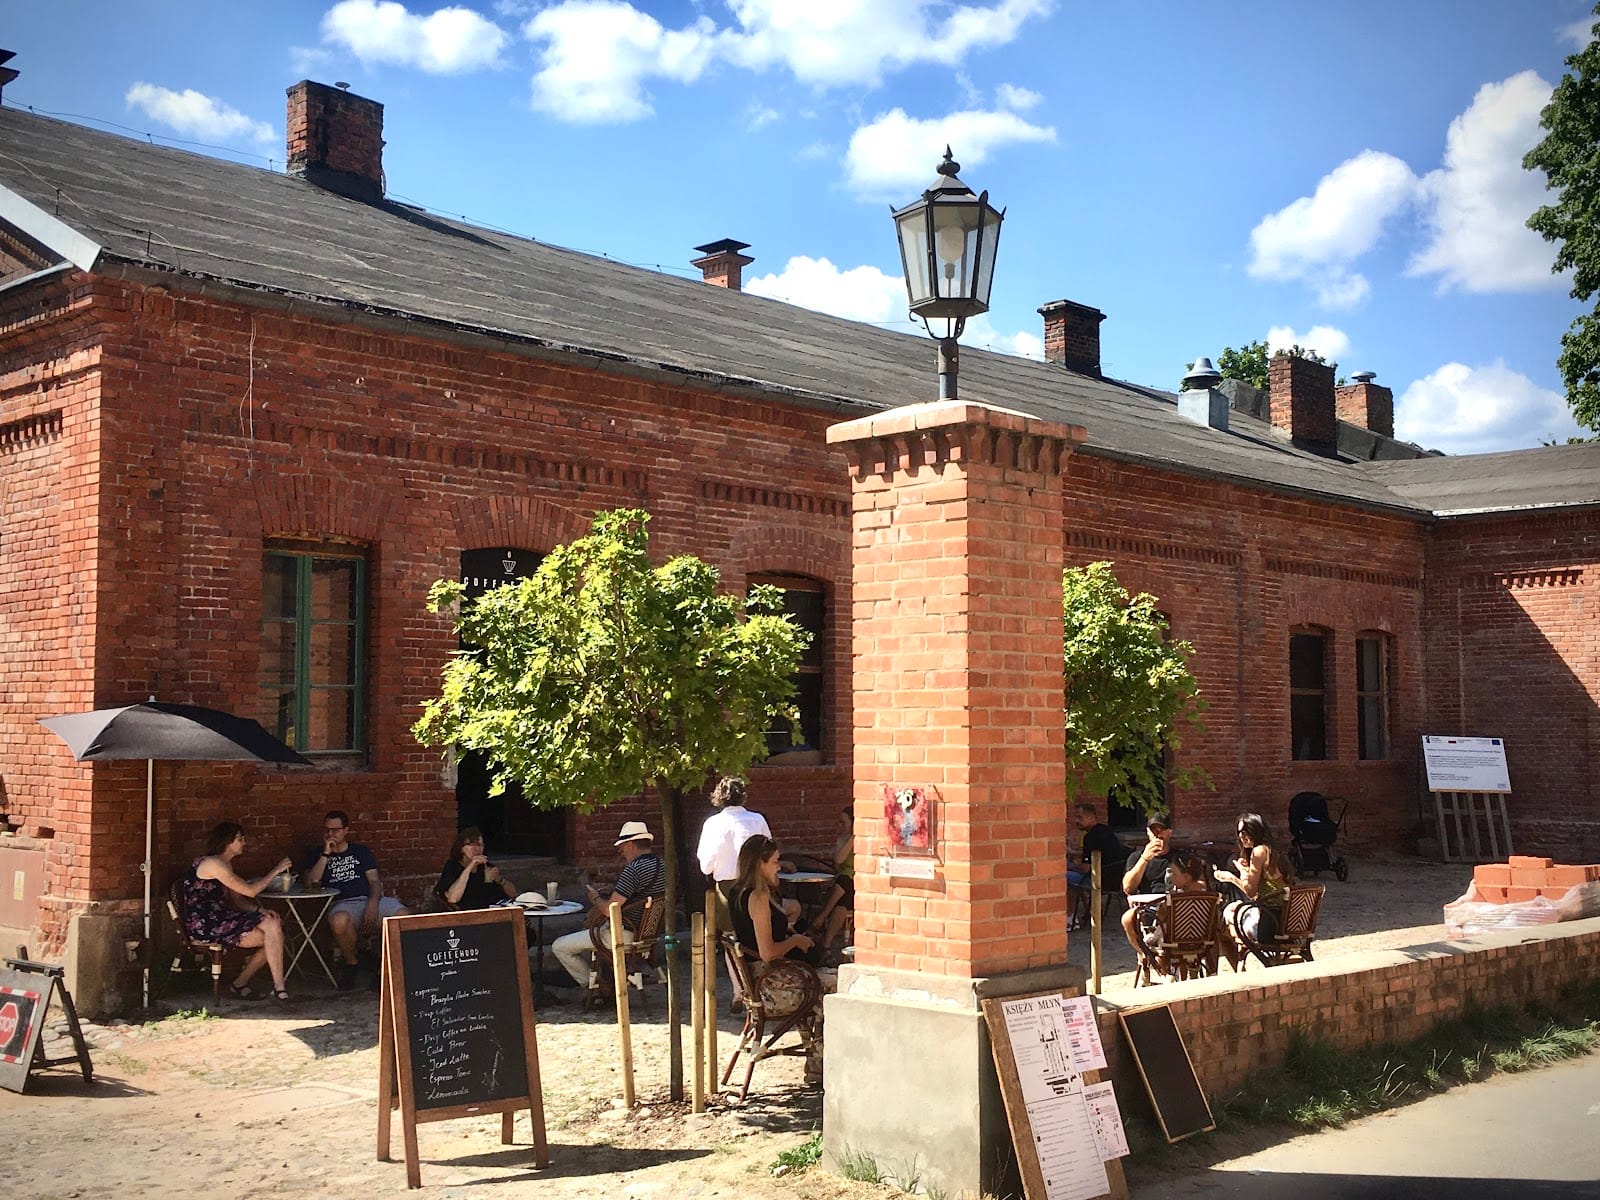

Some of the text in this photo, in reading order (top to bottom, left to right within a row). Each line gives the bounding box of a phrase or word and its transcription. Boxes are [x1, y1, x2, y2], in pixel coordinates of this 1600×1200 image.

[1005, 1002, 1033, 1016] KSIĘŻY
[1038, 998, 1061, 1011] MŁYN
[0, 1014, 15, 1033] TOP
